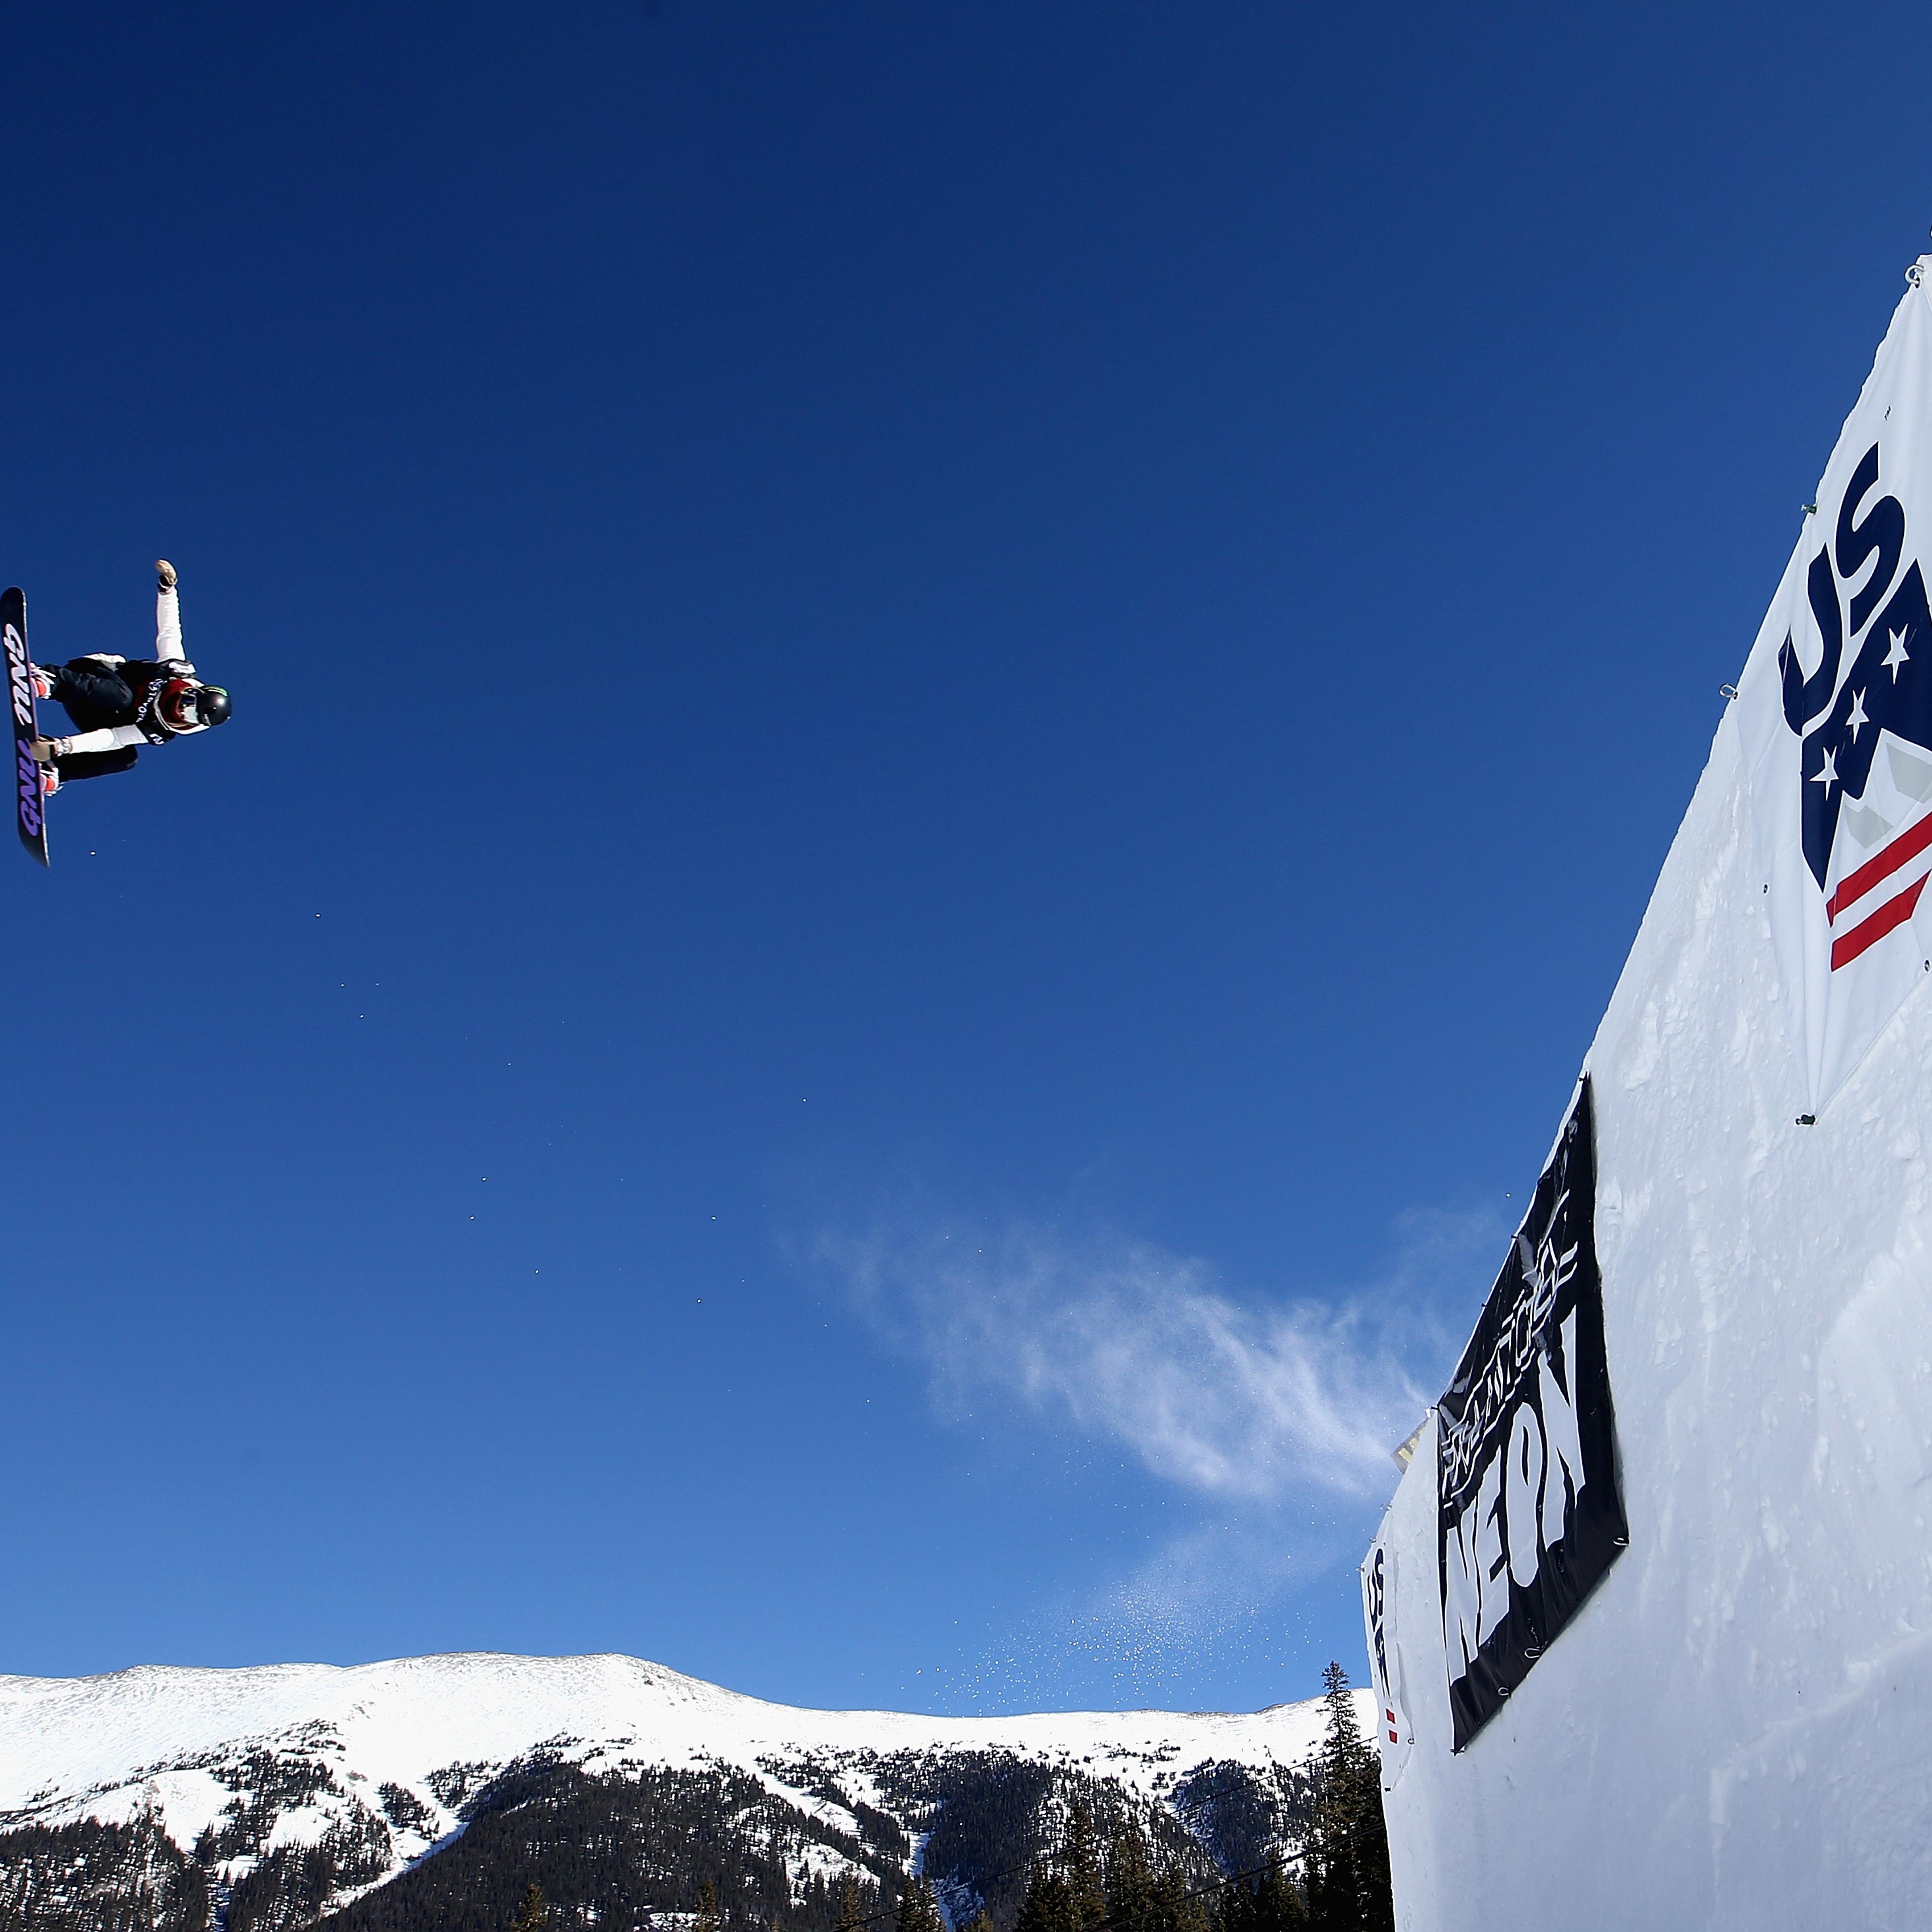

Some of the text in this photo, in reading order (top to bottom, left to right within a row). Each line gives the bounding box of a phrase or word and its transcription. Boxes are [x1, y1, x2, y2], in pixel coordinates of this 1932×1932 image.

[3, 623, 32, 726] GNU
[17, 738, 41, 837] GNU
[1445, 1304, 1586, 1686] NEON
